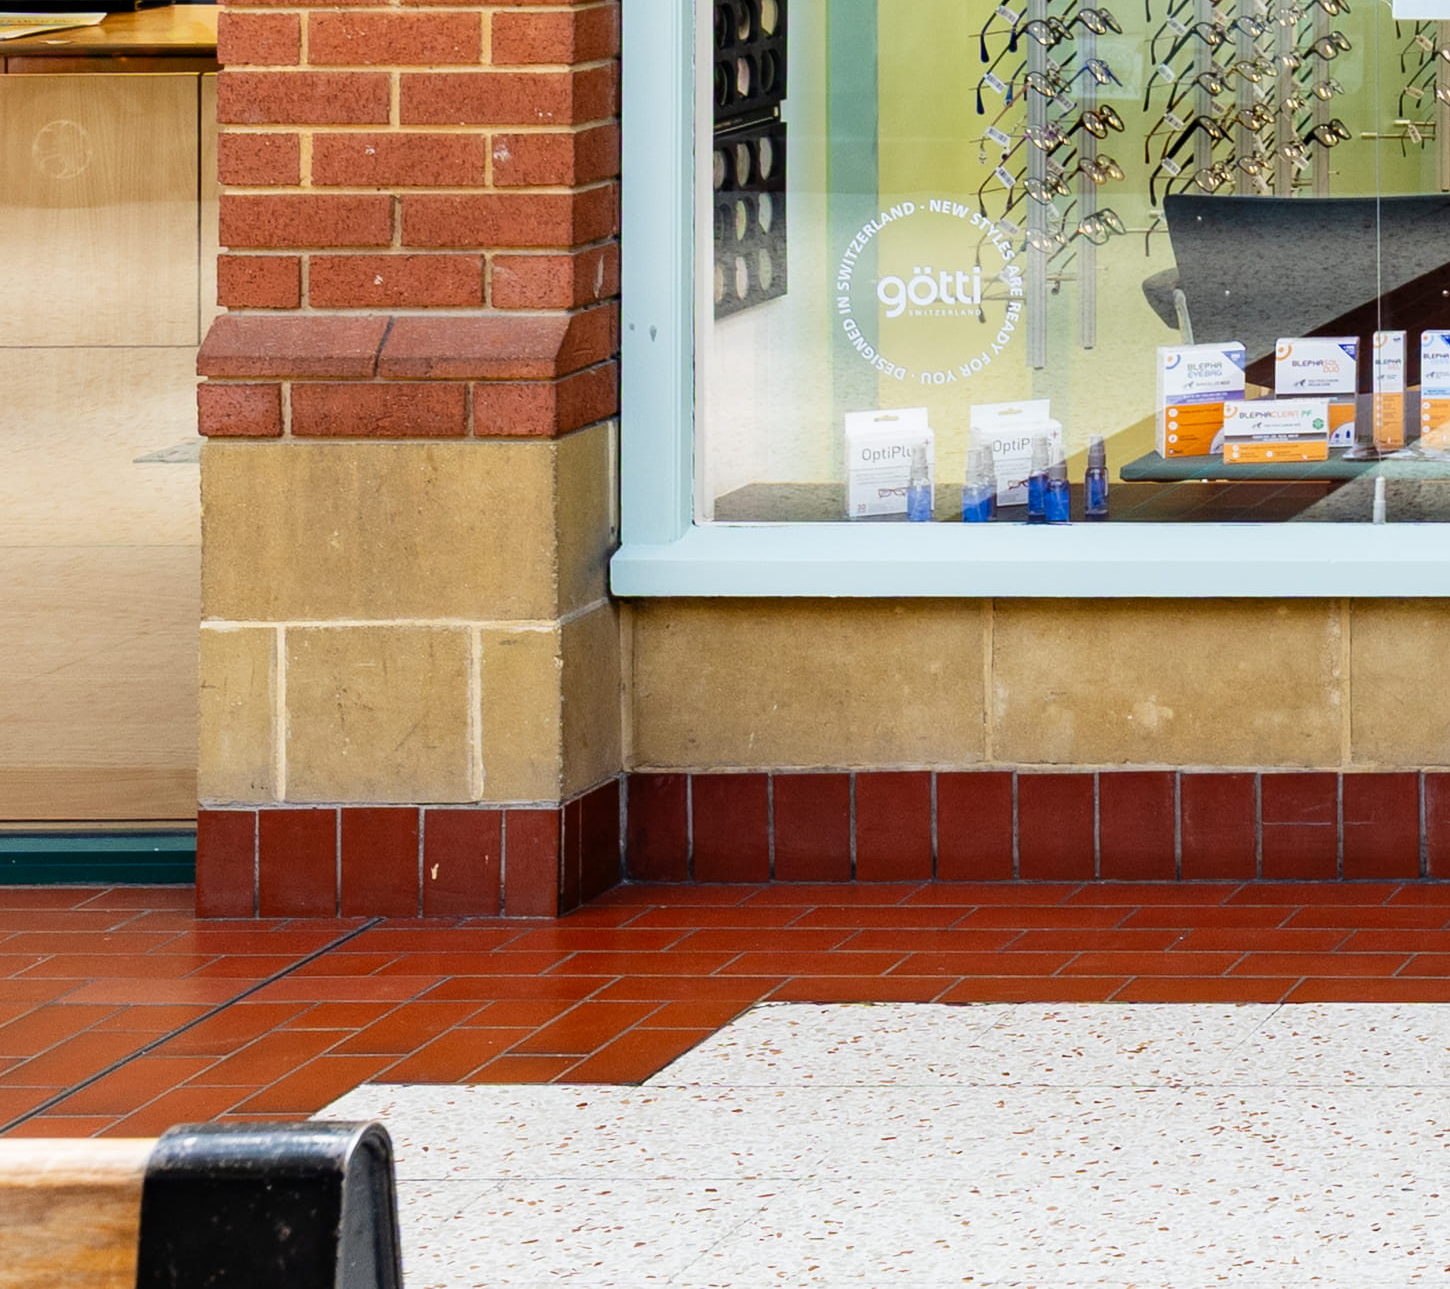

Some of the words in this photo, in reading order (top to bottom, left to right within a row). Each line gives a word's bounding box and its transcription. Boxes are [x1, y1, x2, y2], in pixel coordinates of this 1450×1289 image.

[929, 199, 970, 219] NEW
[836, 200, 916, 292] SWITZERLAND
[968, 213, 1016, 262] STYLES
[876, 265, 983, 319] götti
[1006, 265, 1024, 298] ARE
[836, 296, 852, 315] IN
[908, 309, 983, 317] SWITZERLAND
[990, 301, 1023, 356] READY
[842, 318, 907, 381] DESIGNED
[1423, 352, 1450, 360] BLEPHA
[920, 369, 958, 385] YOU
[958, 351, 993, 378] FOR
[1187, 361, 1223, 371] BLEPHA
